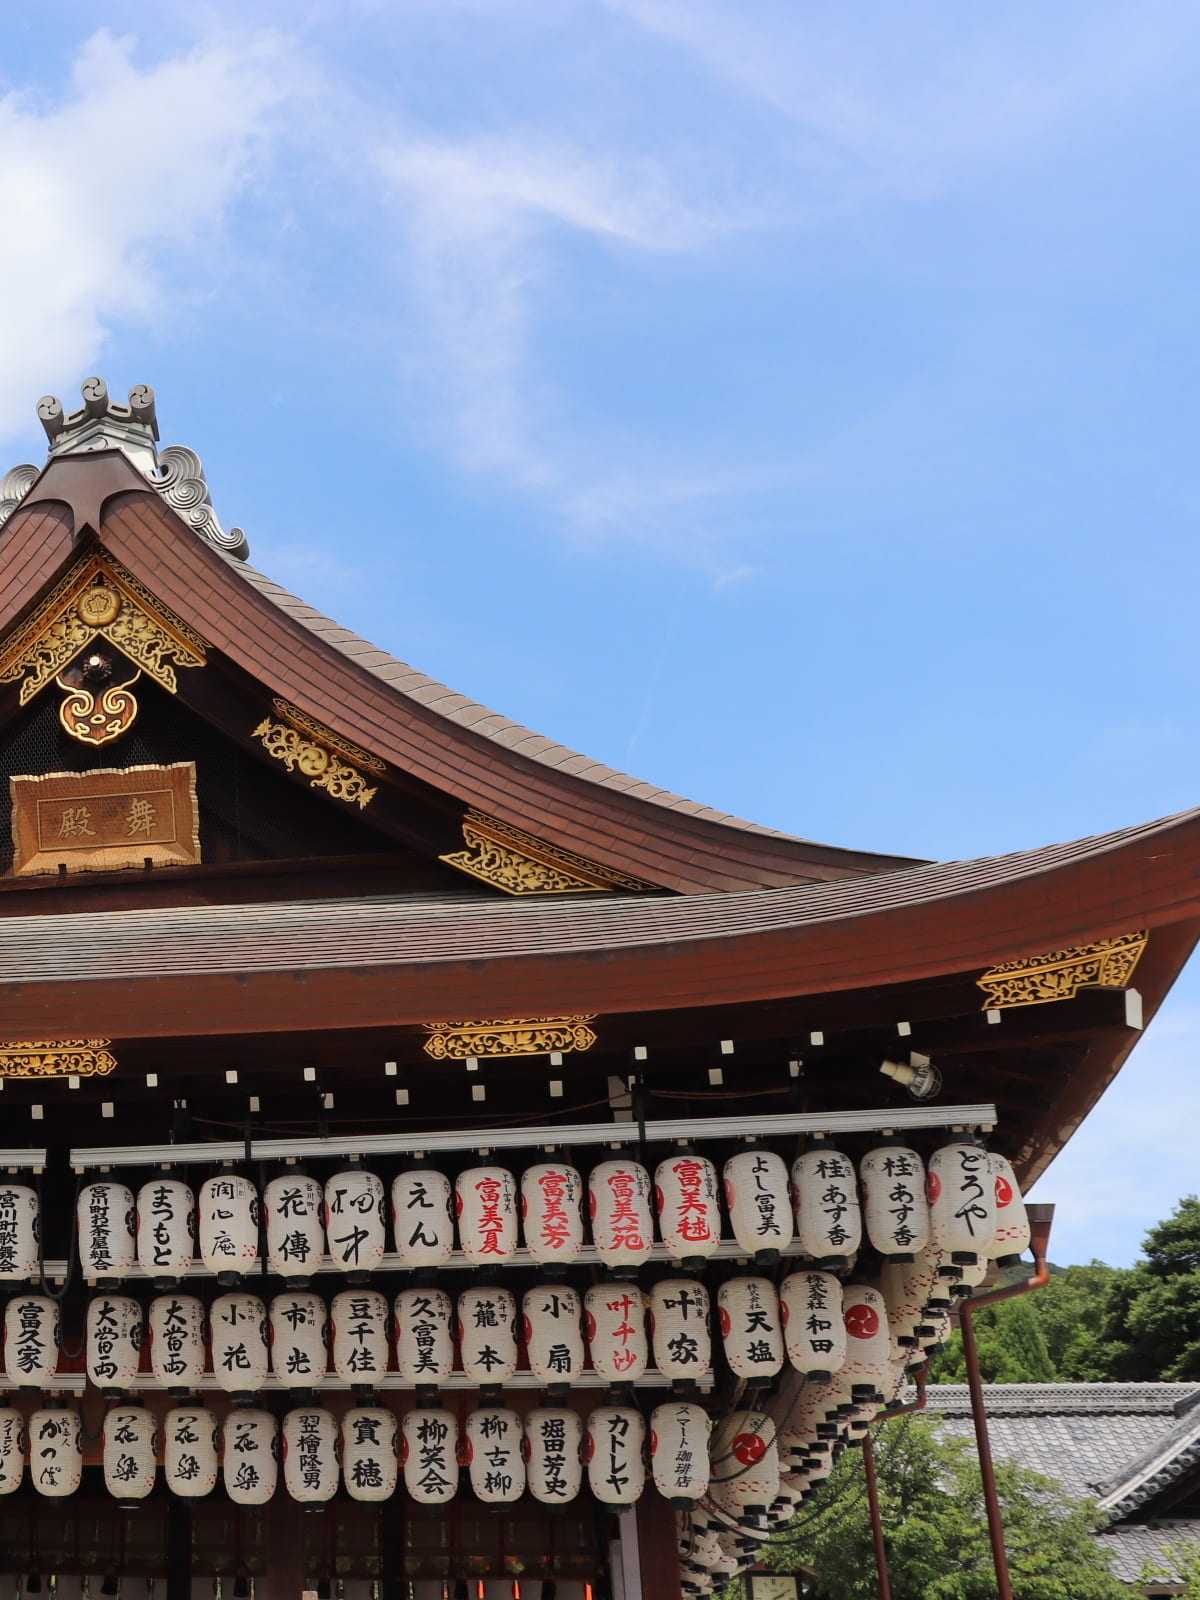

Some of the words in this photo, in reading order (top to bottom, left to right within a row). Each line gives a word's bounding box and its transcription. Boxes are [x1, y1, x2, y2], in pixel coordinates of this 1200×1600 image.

[89, 1185, 115, 1271] 宮川町お茶屋組合
[151, 1185, 175, 1267] まつもと
[407, 1182, 439, 1248] えん
[474, 1176, 508, 1256] 富美夏
[538, 1170, 571, 1249] 富美芳
[607, 1169, 645, 1251] 富美苑
[813, 1159, 851, 1246] 桂あす香
[881, 1155, 918, 1247] 桂あす香
[954, 1150, 988, 1238] どろや
[14, 1301, 46, 1374] 富久家
[221, 1304, 252, 1372] 小花
[281, 1302, 312, 1375] 市光
[347, 1297, 377, 1373] 豆千佳
[409, 1296, 440, 1374] 久富美
[541, 1294, 572, 1374] 小扇
[663, 1290, 699, 1365] 叶家
[804, 1274, 834, 1354] 株式会社和田
[416, 1418, 453, 1495] 柳笑会
[479, 1414, 513, 1497] 柳古柳
[540, 1418, 568, 1497] 堀田芳史
[605, 1414, 630, 1495] カトレヤ
[673, 1405, 695, 1488] スマート珈琲店
